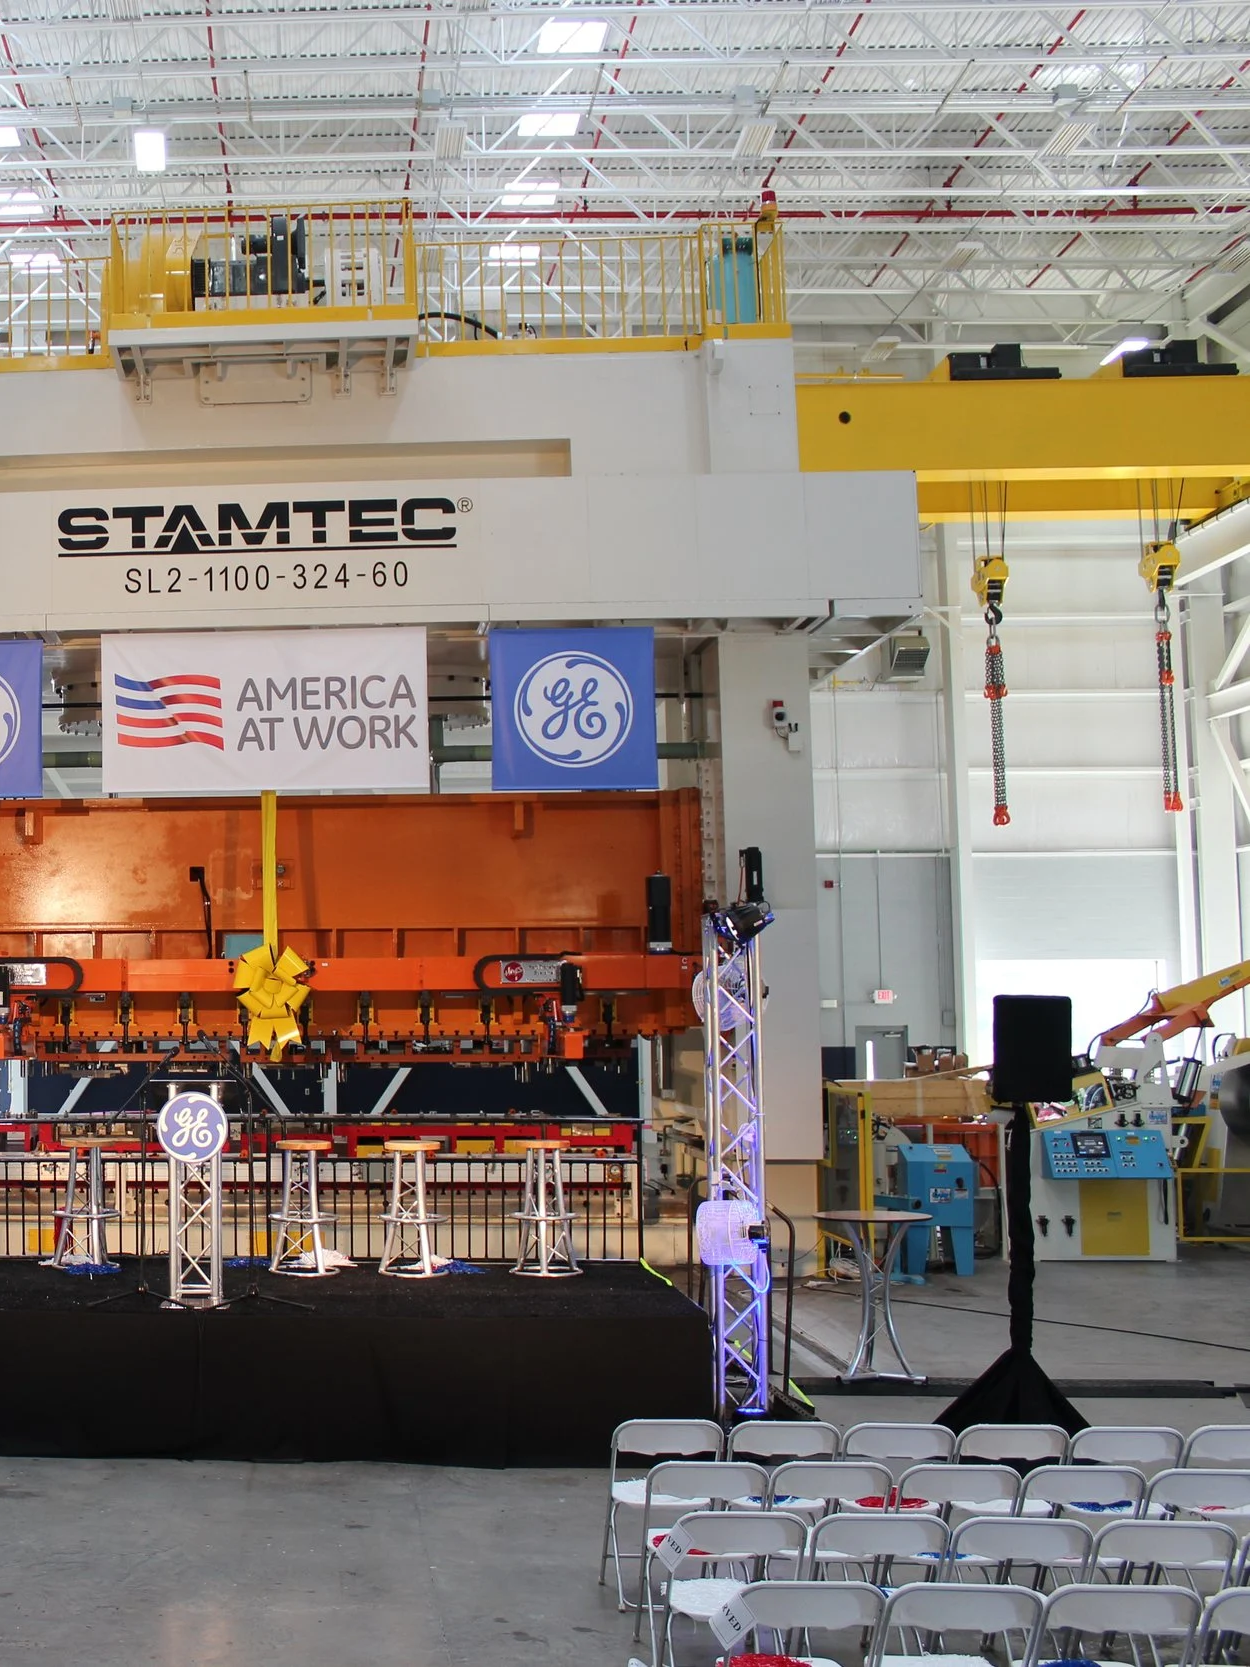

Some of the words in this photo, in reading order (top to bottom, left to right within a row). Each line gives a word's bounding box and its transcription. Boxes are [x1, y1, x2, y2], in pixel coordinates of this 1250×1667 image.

[125, 561, 410, 594] SL2-1100-324-60
[236, 673, 417, 712] AMERICA
[237, 716, 285, 753] AT
[295, 713, 419, 751] WORK
